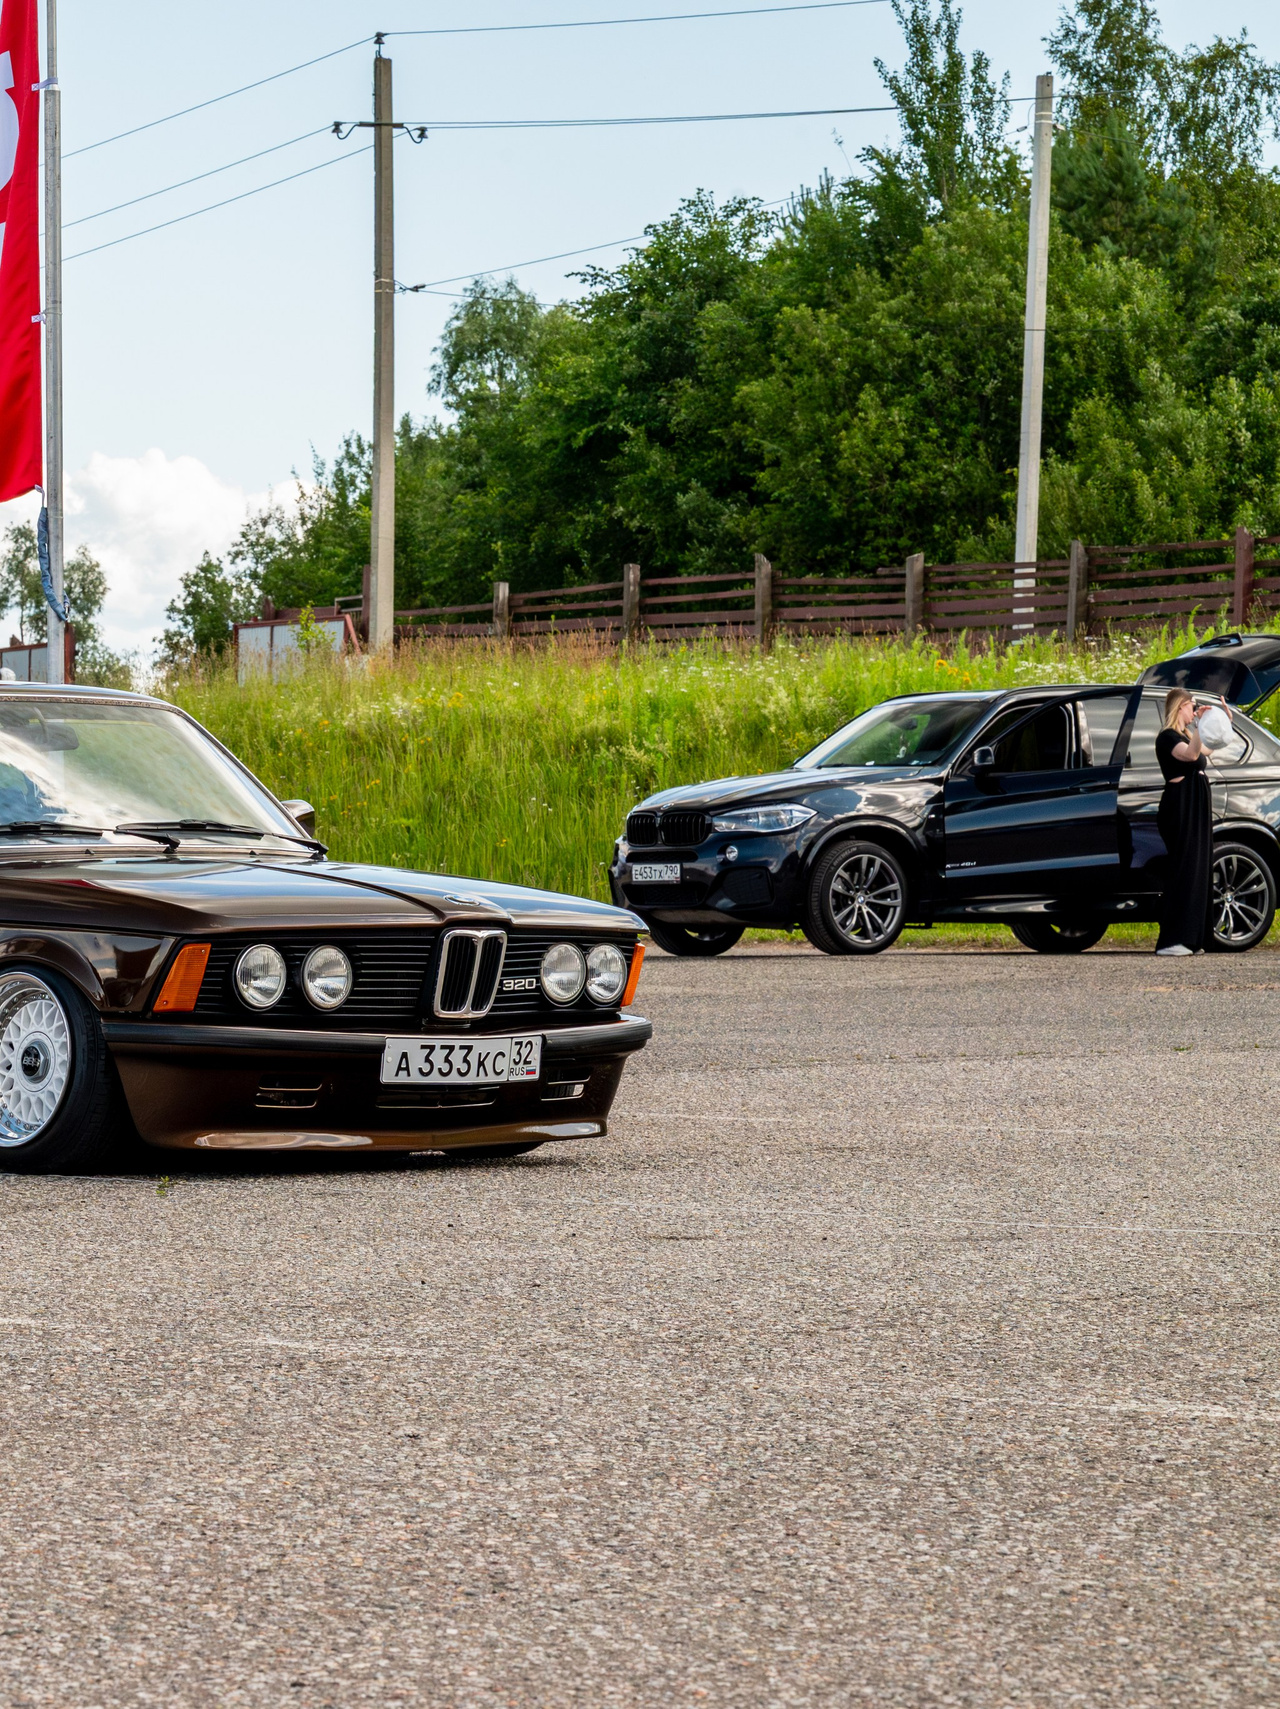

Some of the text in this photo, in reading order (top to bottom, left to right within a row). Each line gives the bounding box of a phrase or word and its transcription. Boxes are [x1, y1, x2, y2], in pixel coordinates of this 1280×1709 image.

[502, 978, 536, 991] 320
[512, 1040, 534, 1066] 32
[509, 1066, 526, 1077] RUS
